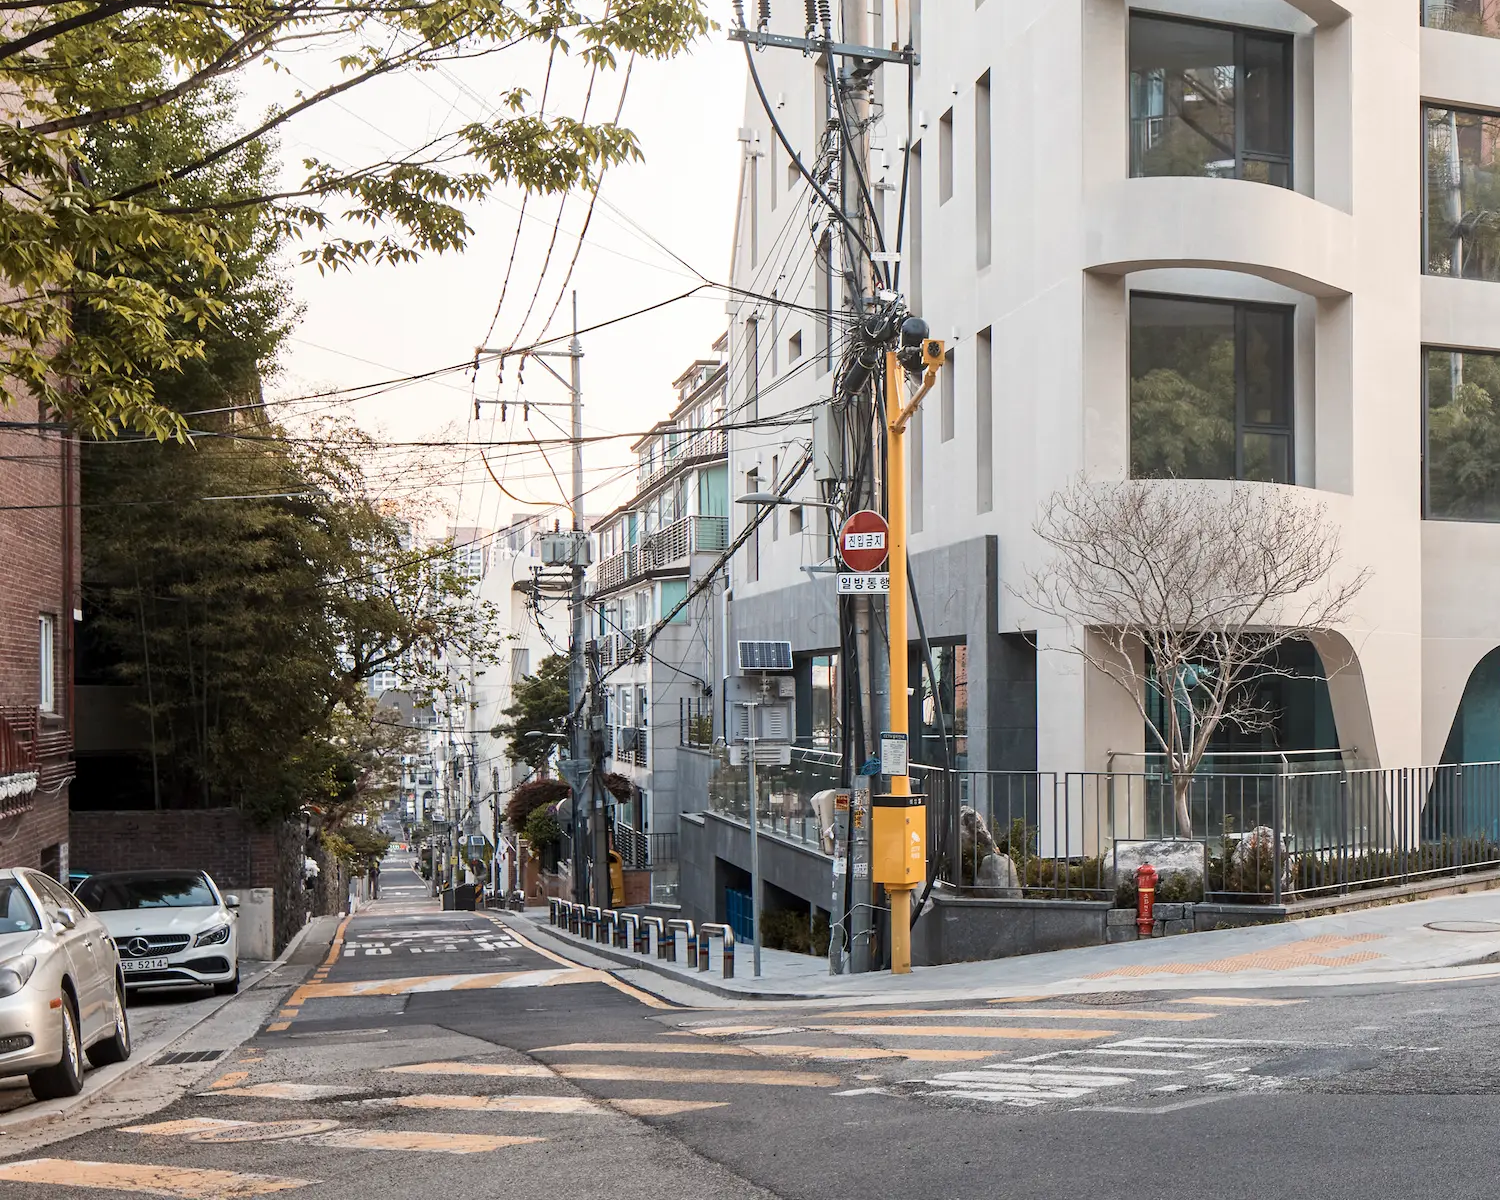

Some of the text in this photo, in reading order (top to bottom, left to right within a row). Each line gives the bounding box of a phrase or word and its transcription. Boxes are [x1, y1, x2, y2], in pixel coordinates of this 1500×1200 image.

[848, 534, 881, 548] 진입금지
[841, 577, 890, 590] 일방통행
[138, 959, 163, 969] 5214
